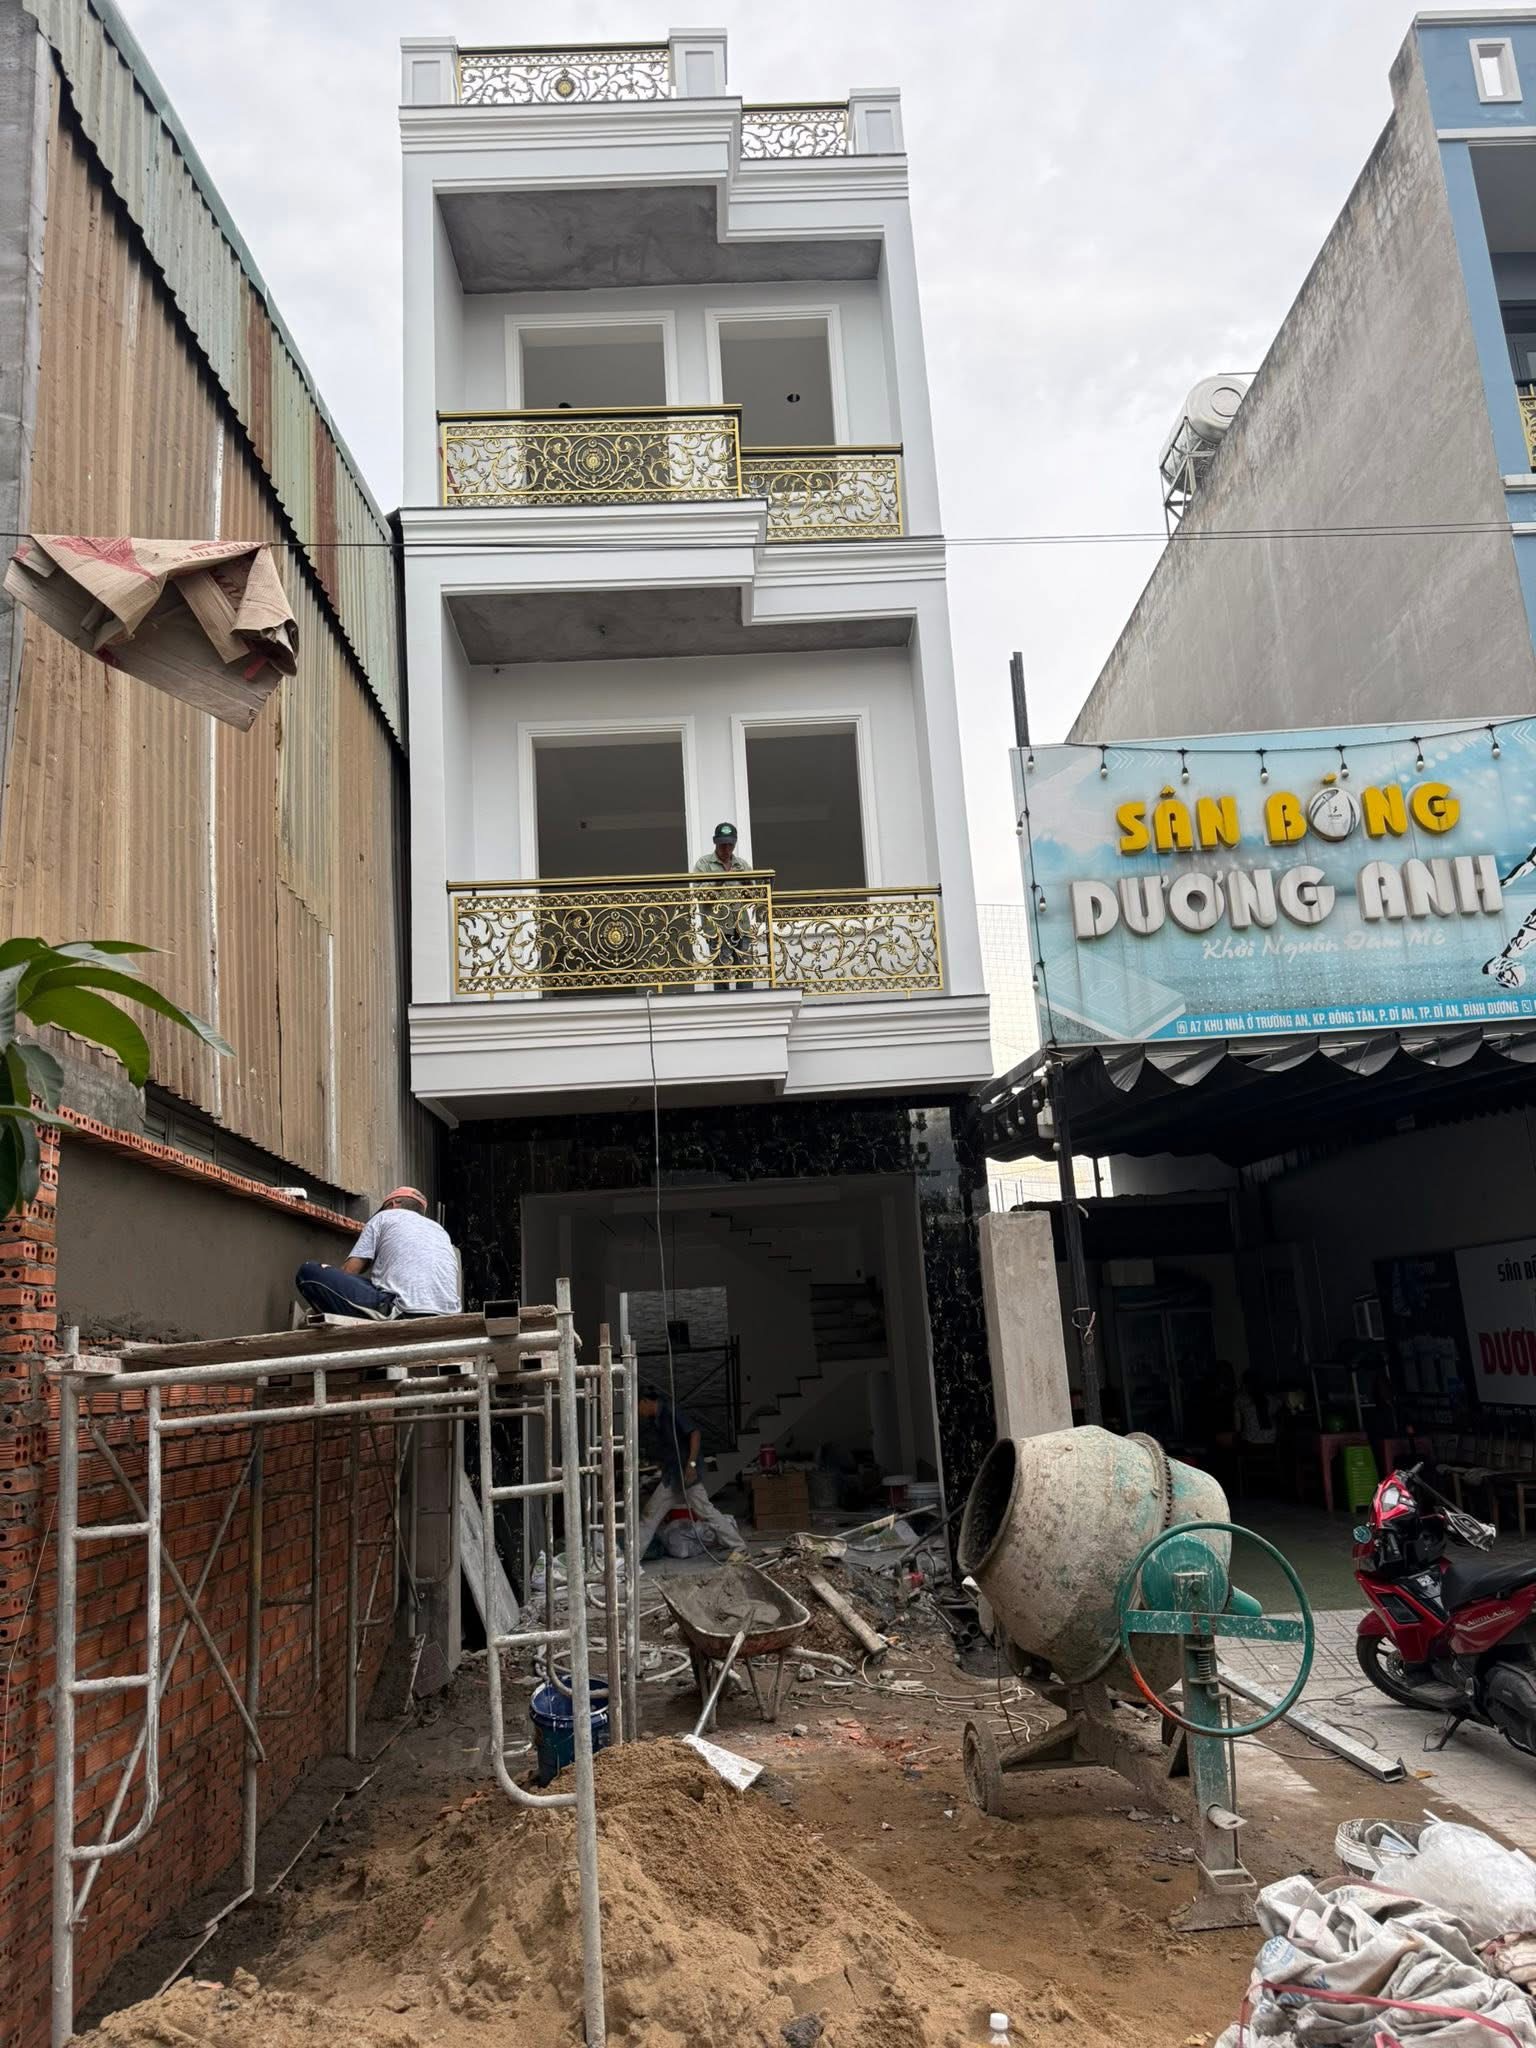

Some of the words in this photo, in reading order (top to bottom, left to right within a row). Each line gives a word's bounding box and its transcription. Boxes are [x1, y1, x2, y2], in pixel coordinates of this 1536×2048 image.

[1115, 785, 1240, 854] SÂN
[1265, 773, 1460, 846] BÓNG
[1070, 865, 1336, 940] DƯƠNG
[1358, 855, 1502, 921] ANH
[1190, 1020, 1201, 1033] A7
[1204, 1019, 1223, 1033] KHU
[1225, 1016, 1246, 1032] NHÀ
[1255, 1012, 1293, 1029] TRƯỜNG
[1295, 1014, 1312, 1028] AN,
[1313, 1012, 1328, 1025] KP.
[1379, 1009, 1387, 1021] P.
[1401, 1007, 1418, 1021] AN,
[1418, 1006, 1433, 1019] TP.
[1446, 1004, 1463, 1018] AN,
[1463, 1001, 1486, 1016] BÌNH
[1487, 999, 1520, 1015] DƯƠNG
[1497, 1257, 1523, 1282] SÂN
